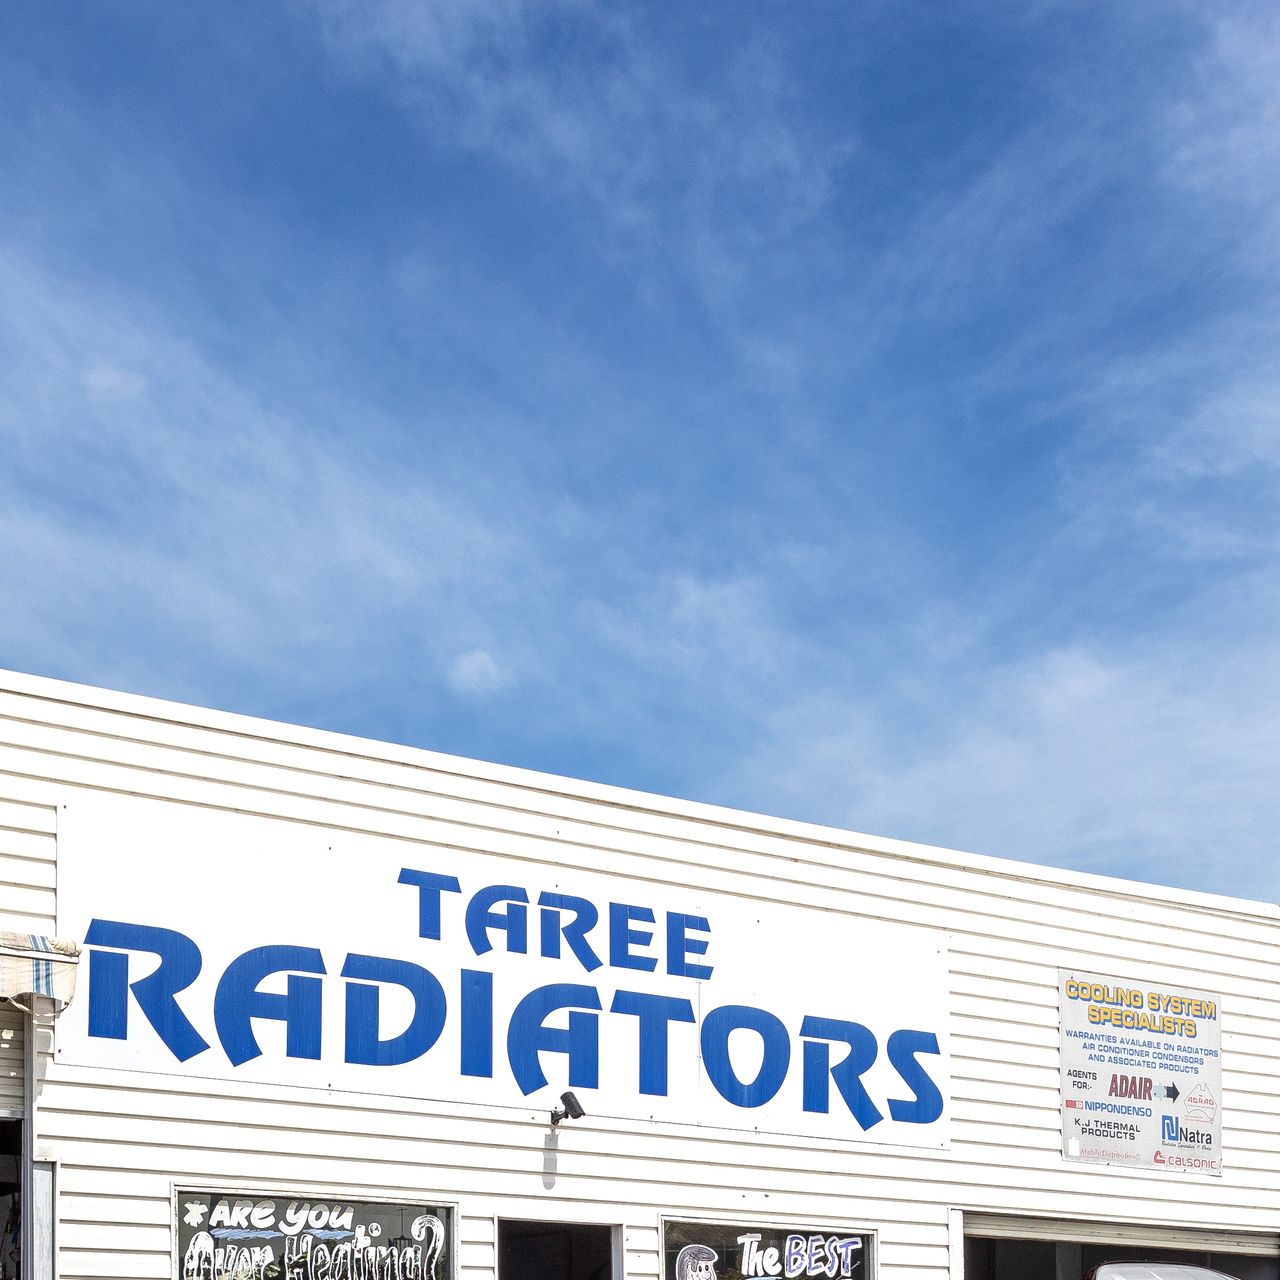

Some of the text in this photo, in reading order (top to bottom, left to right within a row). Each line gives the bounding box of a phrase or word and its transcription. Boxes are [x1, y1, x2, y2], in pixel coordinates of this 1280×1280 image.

[397, 867, 714, 980] TAREE
[1065, 979, 1217, 1021] COOLING SYSTEM
[83, 918, 944, 1132] RADIATORS
[1088, 1005, 1197, 1038] SPECIALISTS
[1065, 1029, 1219, 1057] WARRANTIES AVAILABLE ON RADIATORS
[1082, 1042, 1204, 1065] AIR CONDITIONER CONDENSORS
[1066, 1069, 1097, 1081] AGENTS
[1088, 1053, 1199, 1075] AND ASSOCIATED PRODUCTS
[1108, 1074, 1153, 1100] ADAIR
[1084, 1101, 1152, 1117] NIPPONDENSO
[1081, 1127, 1136, 1141] PRODUCTS
[1094, 1120, 1141, 1133] THERMAL
[1179, 1126, 1212, 1145] Natra
[737, 1233, 862, 1277] The BEST
